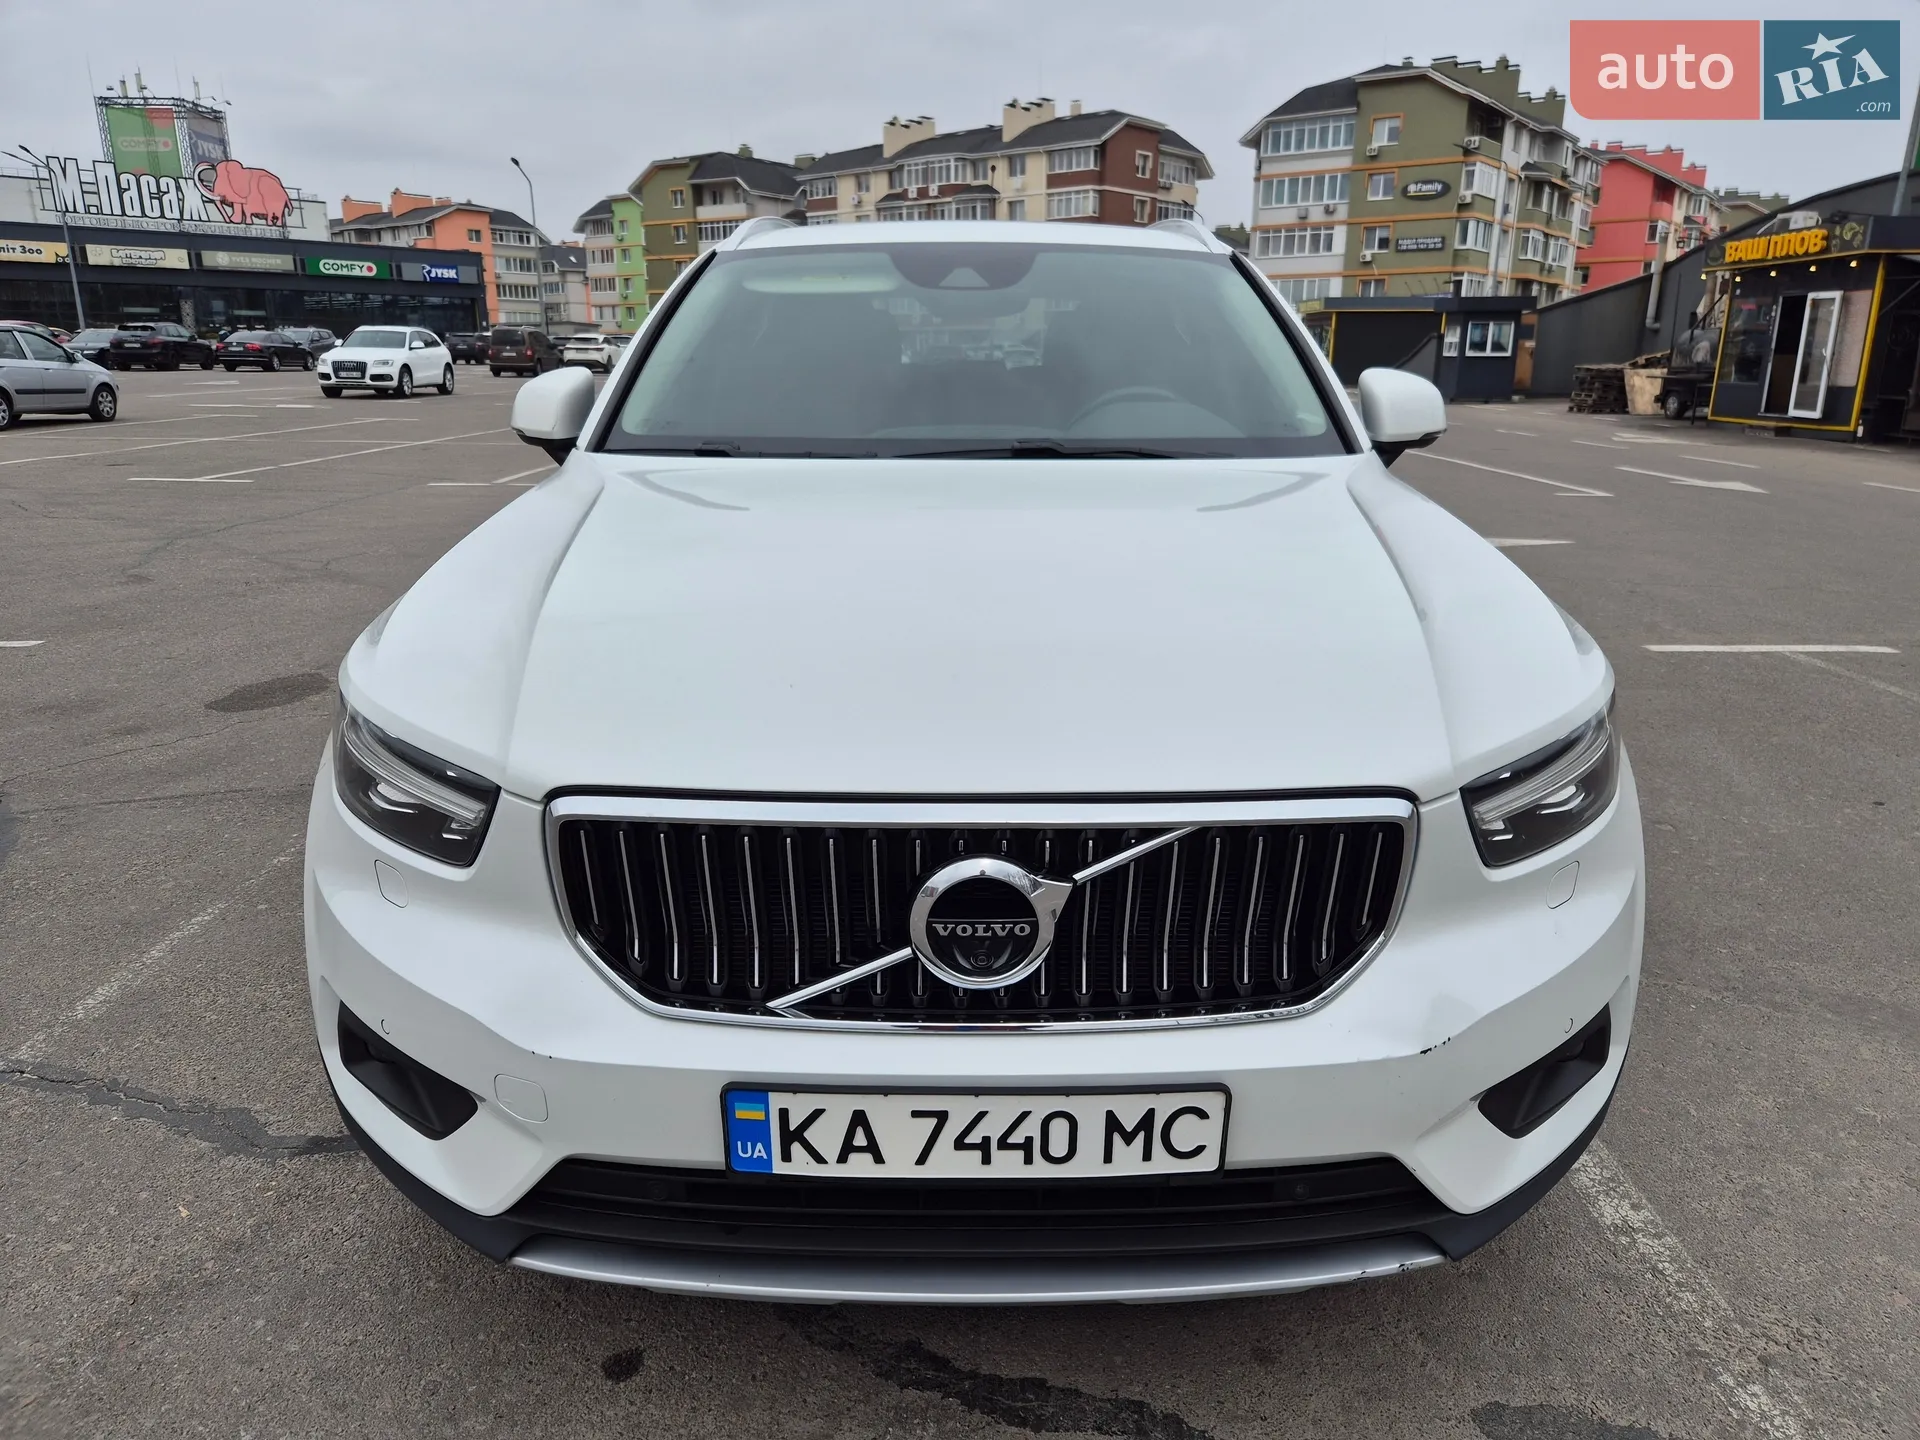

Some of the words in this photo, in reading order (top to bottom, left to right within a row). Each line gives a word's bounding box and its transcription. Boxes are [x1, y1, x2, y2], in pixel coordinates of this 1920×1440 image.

[1417, 181, 1443, 192] Family
[19, 245, 43, 255] Зоо
[1724, 236, 1769, 263] ВАШ
[1768, 229, 1828, 259] ПЛОВ
[323, 261, 365, 273] COMFY
[430, 267, 458, 279] JYSK
[932, 922, 1031, 938] VOLVO
[778, 1107, 885, 1166] KA
[910, 1109, 1078, 1166] 7440
[1103, 1105, 1210, 1163] MC
[737, 1140, 768, 1160] UA
